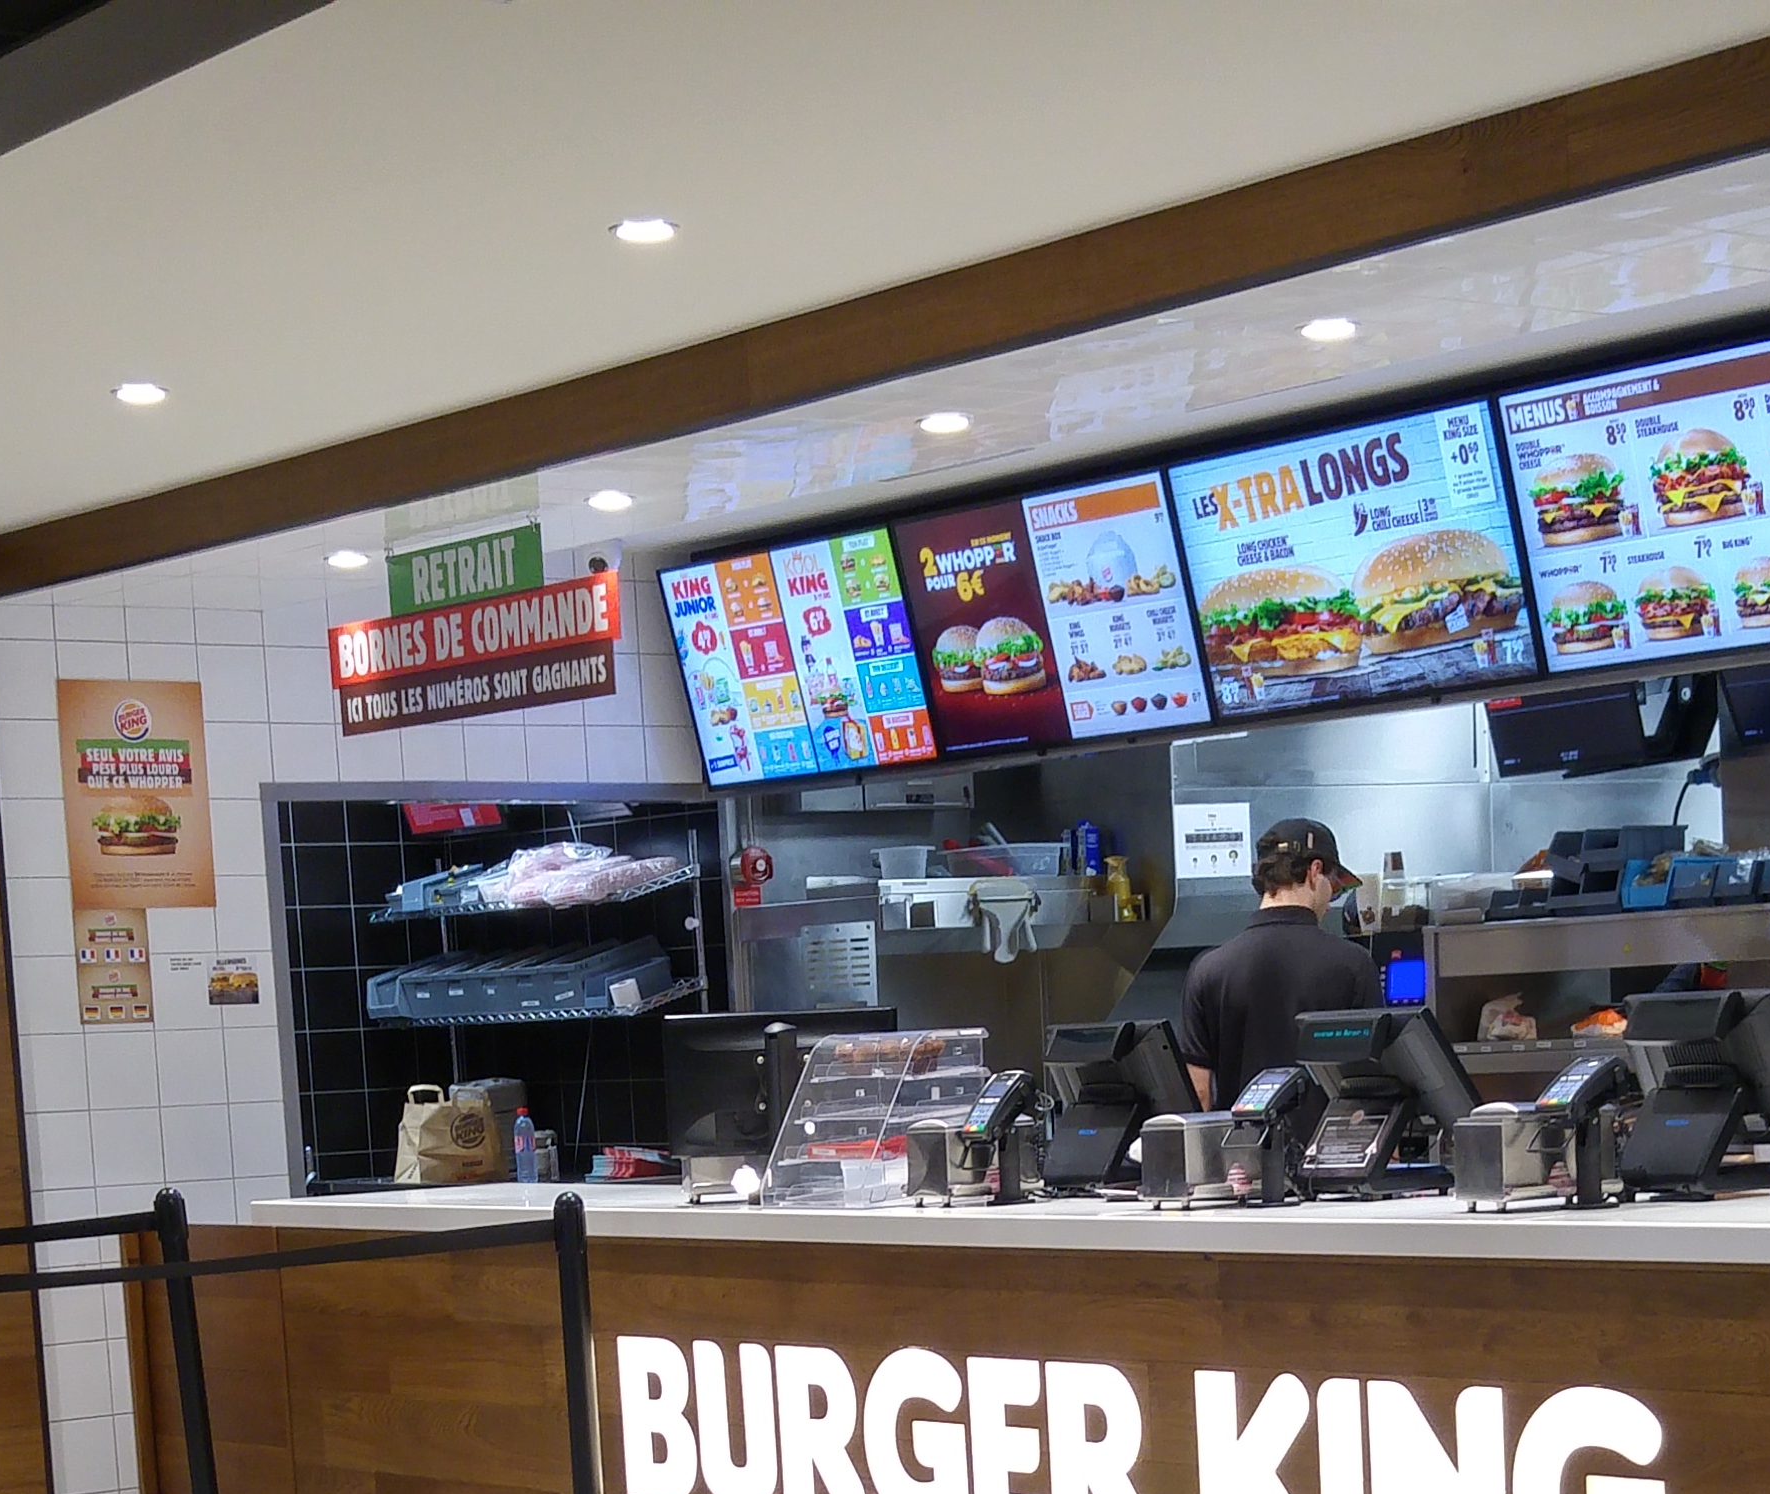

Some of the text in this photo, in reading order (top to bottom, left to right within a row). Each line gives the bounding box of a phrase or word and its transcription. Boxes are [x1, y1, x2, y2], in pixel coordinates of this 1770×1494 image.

[1582, 379, 1653, 405] ACCOMPAGNEMENT
[1508, 397, 1566, 432] MENUS
[1583, 400, 1618, 416] BOISSON
[1446, 414, 1470, 427] MENU
[1635, 414, 1662, 428] DOUBLE
[1636, 421, 1679, 438] STEAKHOUSE
[1442, 423, 1479, 442] KING SIZE
[1515, 438, 1541, 452] DOUBLE
[1519, 458, 1542, 471] CHEESE
[1191, 431, 1410, 531] LES X-TRA LONGS
[1031, 500, 1079, 529] SNACKS
[1369, 504, 1392, 520] LONG
[1371, 512, 1421, 532] CHILI CHEESE
[1236, 535, 1289, 555] LONG CHICKEN
[1722, 536, 1752, 550] BIG KING
[782, 552, 824, 577] KOOL
[919, 547, 939, 578] 2
[1237, 551, 1264, 566] CHEESE
[1269, 546, 1295, 561] BACON
[1627, 551, 1665, 565] STEAKHOUSE
[411, 535, 516, 606] RETRAIT
[671, 575, 712, 601] KING
[787, 571, 829, 597] KING
[925, 569, 986, 602] POUR 6€
[674, 595, 717, 618] JUNIOR
[337, 582, 610, 679] BORNES DE COMMANDE
[346, 654, 607, 724] ICI TOUS LES NUMÉROS SONT GAGNANTS
[119, 715, 148, 733] KING
[86, 748, 185, 763] SEUL VOTRE AVIS
[119, 763, 145, 775] PLUS
[146, 763, 180, 775] LOURD
[87, 775, 184, 790] QUE CE WHOPPER
